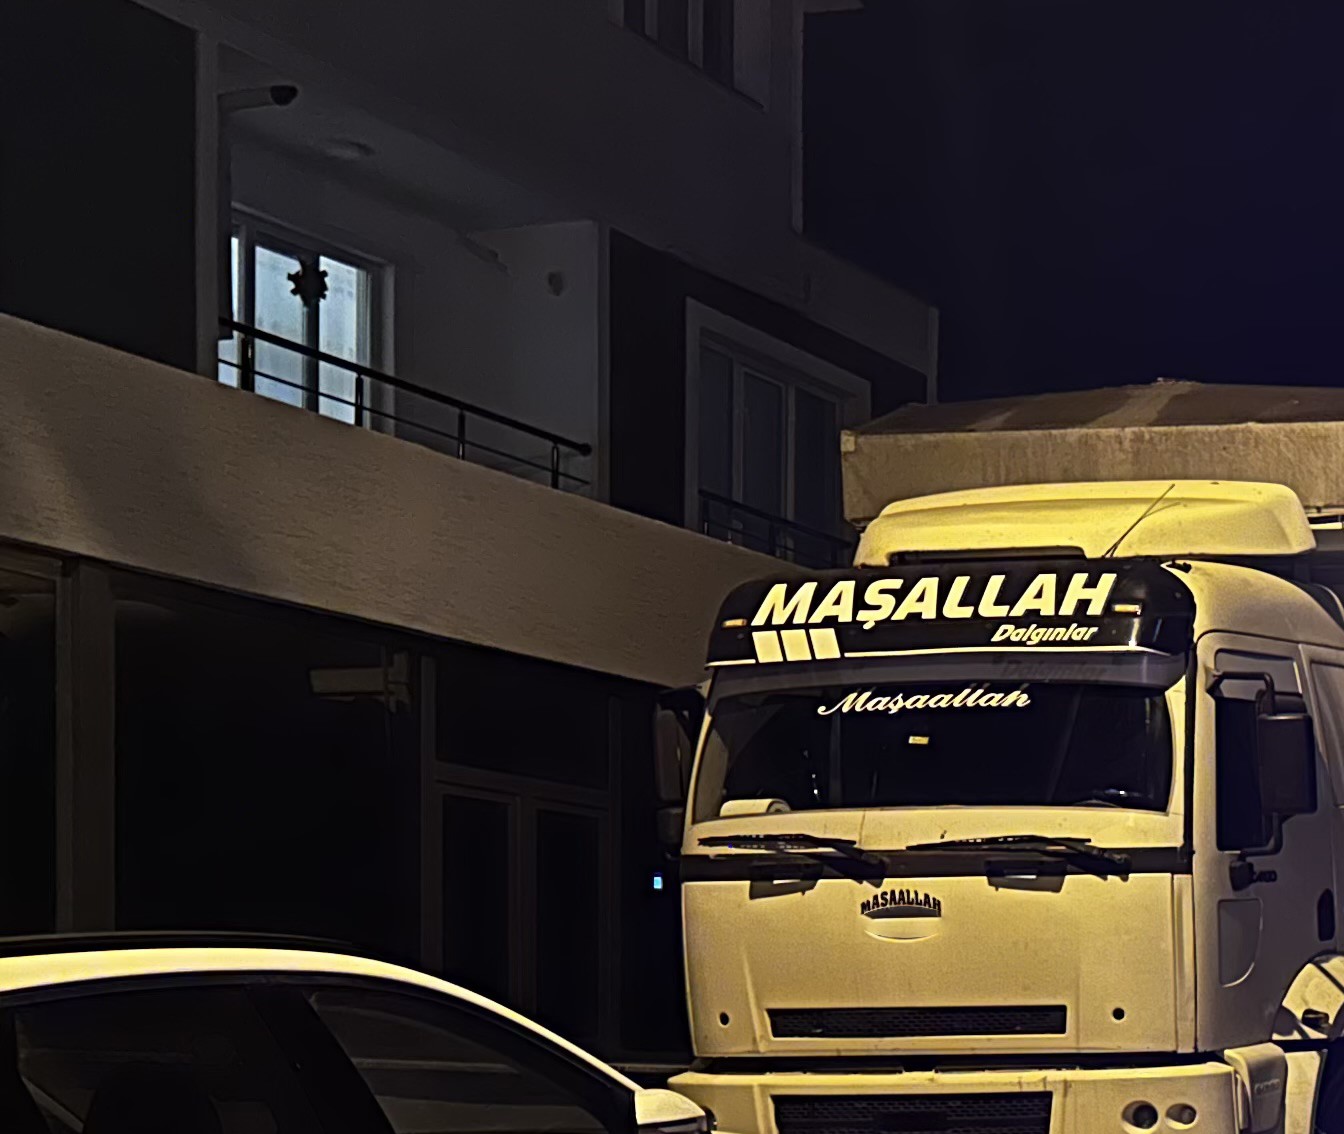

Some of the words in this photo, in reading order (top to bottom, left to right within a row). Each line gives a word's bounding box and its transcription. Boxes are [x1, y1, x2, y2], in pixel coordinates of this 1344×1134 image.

[751, 573, 1117, 630] MAŞALLAH
[990, 623, 1099, 645] Dalgınlar
[817, 688, 1031, 715] Maşaallah
